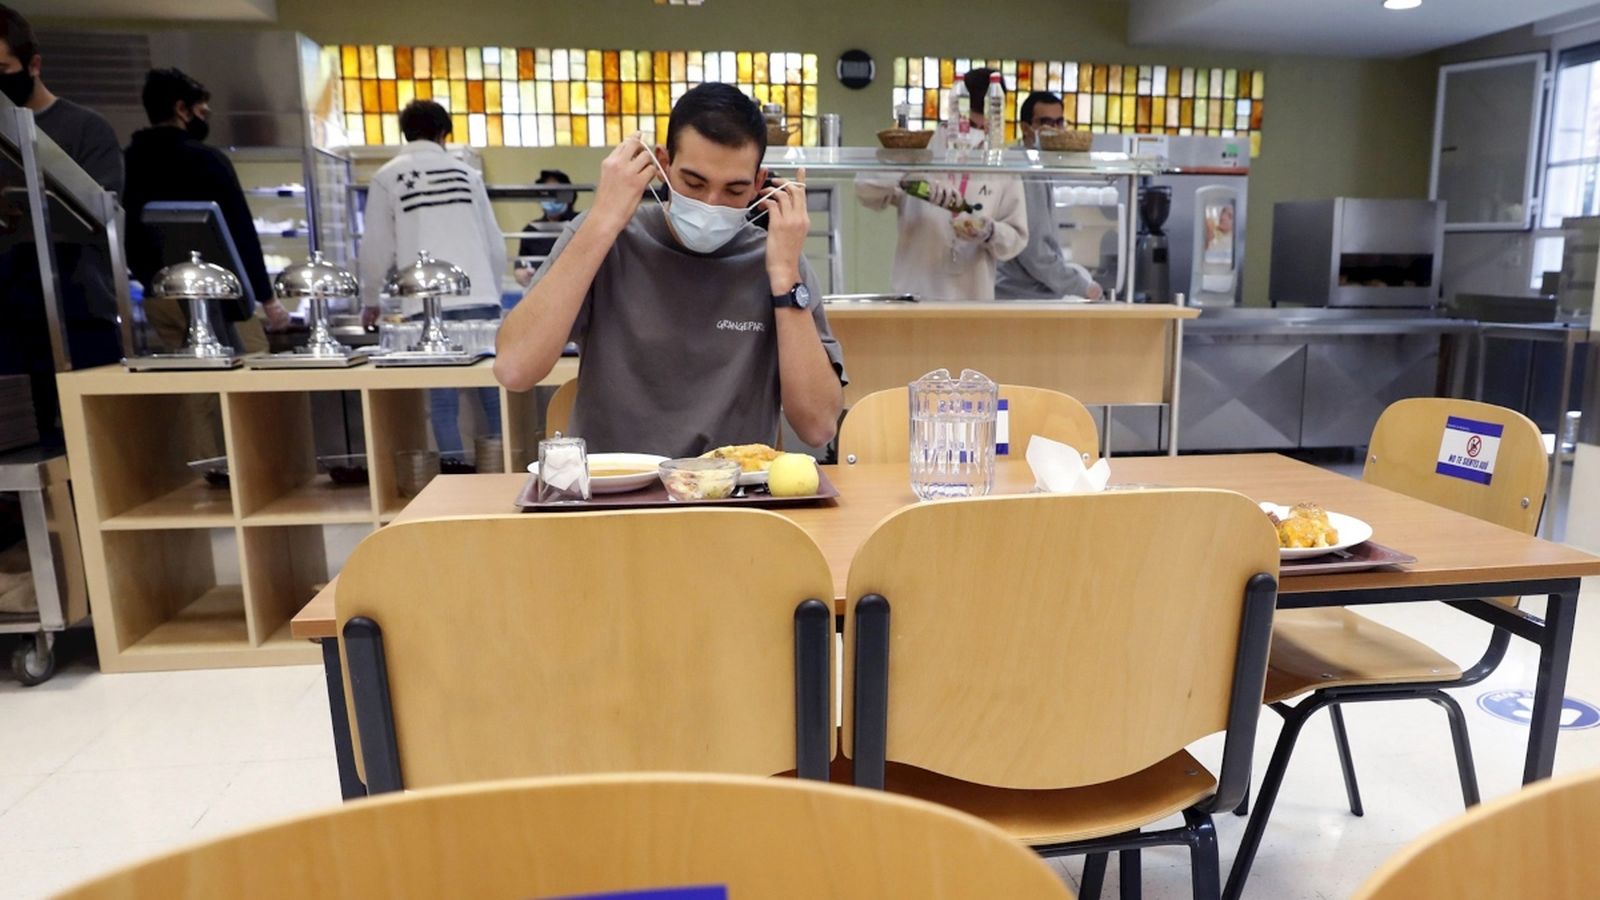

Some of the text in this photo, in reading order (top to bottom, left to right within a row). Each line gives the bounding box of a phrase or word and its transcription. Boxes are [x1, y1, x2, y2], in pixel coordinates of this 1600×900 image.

[1448, 454, 1457, 463] NO
[1456, 455, 1463, 465] TE
[1462, 457, 1480, 468] SIENTES
